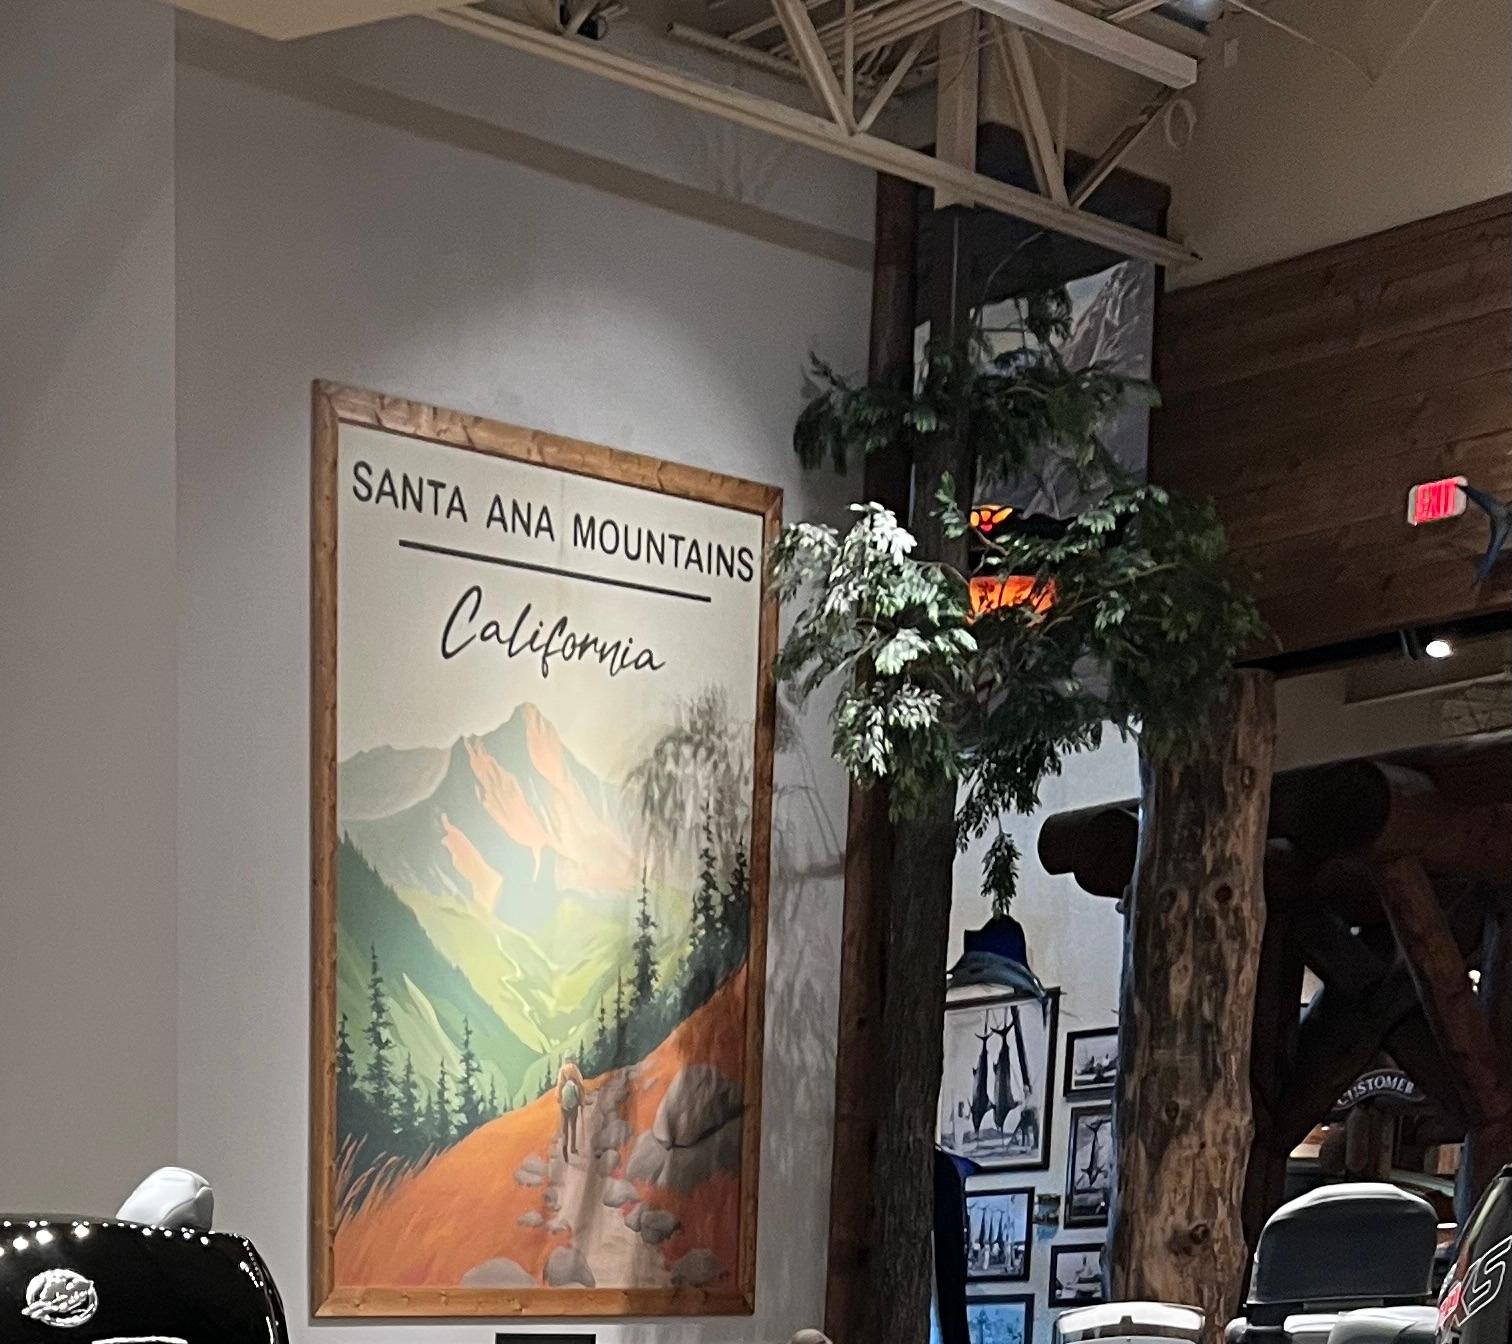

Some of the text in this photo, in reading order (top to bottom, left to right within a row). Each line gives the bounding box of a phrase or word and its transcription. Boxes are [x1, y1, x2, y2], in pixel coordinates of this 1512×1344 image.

[352, 460, 755, 583] SANTA ANA MOUNTAINS
[440, 584, 667, 679] California
